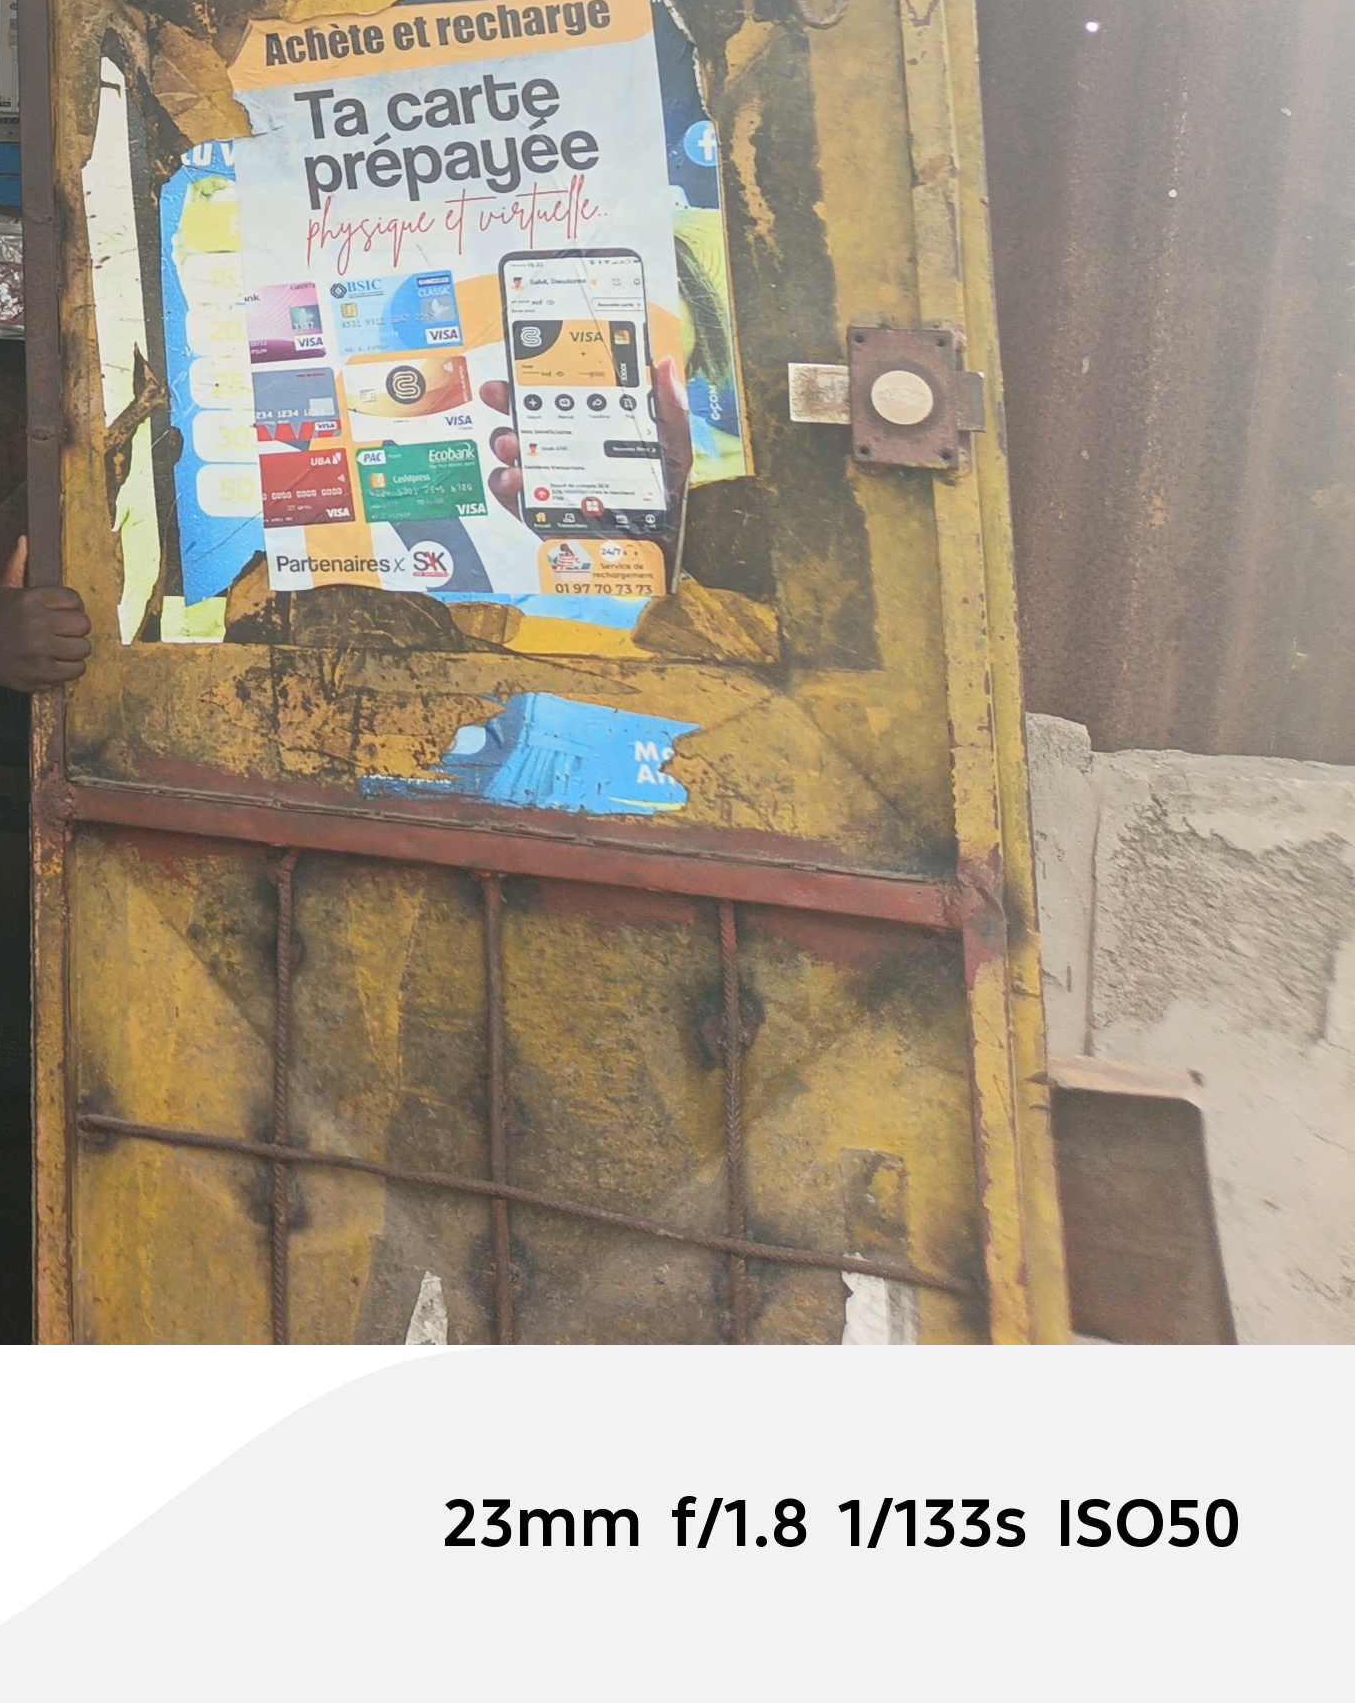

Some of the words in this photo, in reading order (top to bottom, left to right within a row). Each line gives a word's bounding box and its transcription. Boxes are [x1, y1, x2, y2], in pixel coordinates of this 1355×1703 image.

[265, 23, 384, 66] Achète
[393, 16, 430, 51] et
[295, 89, 369, 139] Ta
[387, 74, 559, 132] carte
[304, 117, 599, 210] prépayée
[307, 195, 435, 275] physique
[444, 188, 497, 254] et
[347, 279, 382, 292] BSIC
[428, 329, 459, 341] VISA
[569, 331, 604, 343] VISA
[297, 337, 324, 348] VISA
[444, 415, 472, 426] VISA
[363, 452, 382, 462] PAC
[429, 445, 475, 462] Ecobank
[311, 456, 331, 466] UBA
[325, 508, 350, 518] VISA
[456, 503, 487, 515] VISA
[601, 547, 621, 556] 24/7
[277, 554, 391, 573] Partenaires
[633, 562, 644, 570] de
[593, 572, 653, 580] rechargement
[555, 584, 569, 594] 01
[573, 584, 590, 594] 97
[594, 584, 611, 594] 70
[616, 584, 631, 594] 73
[636, 584, 652, 594] 73
